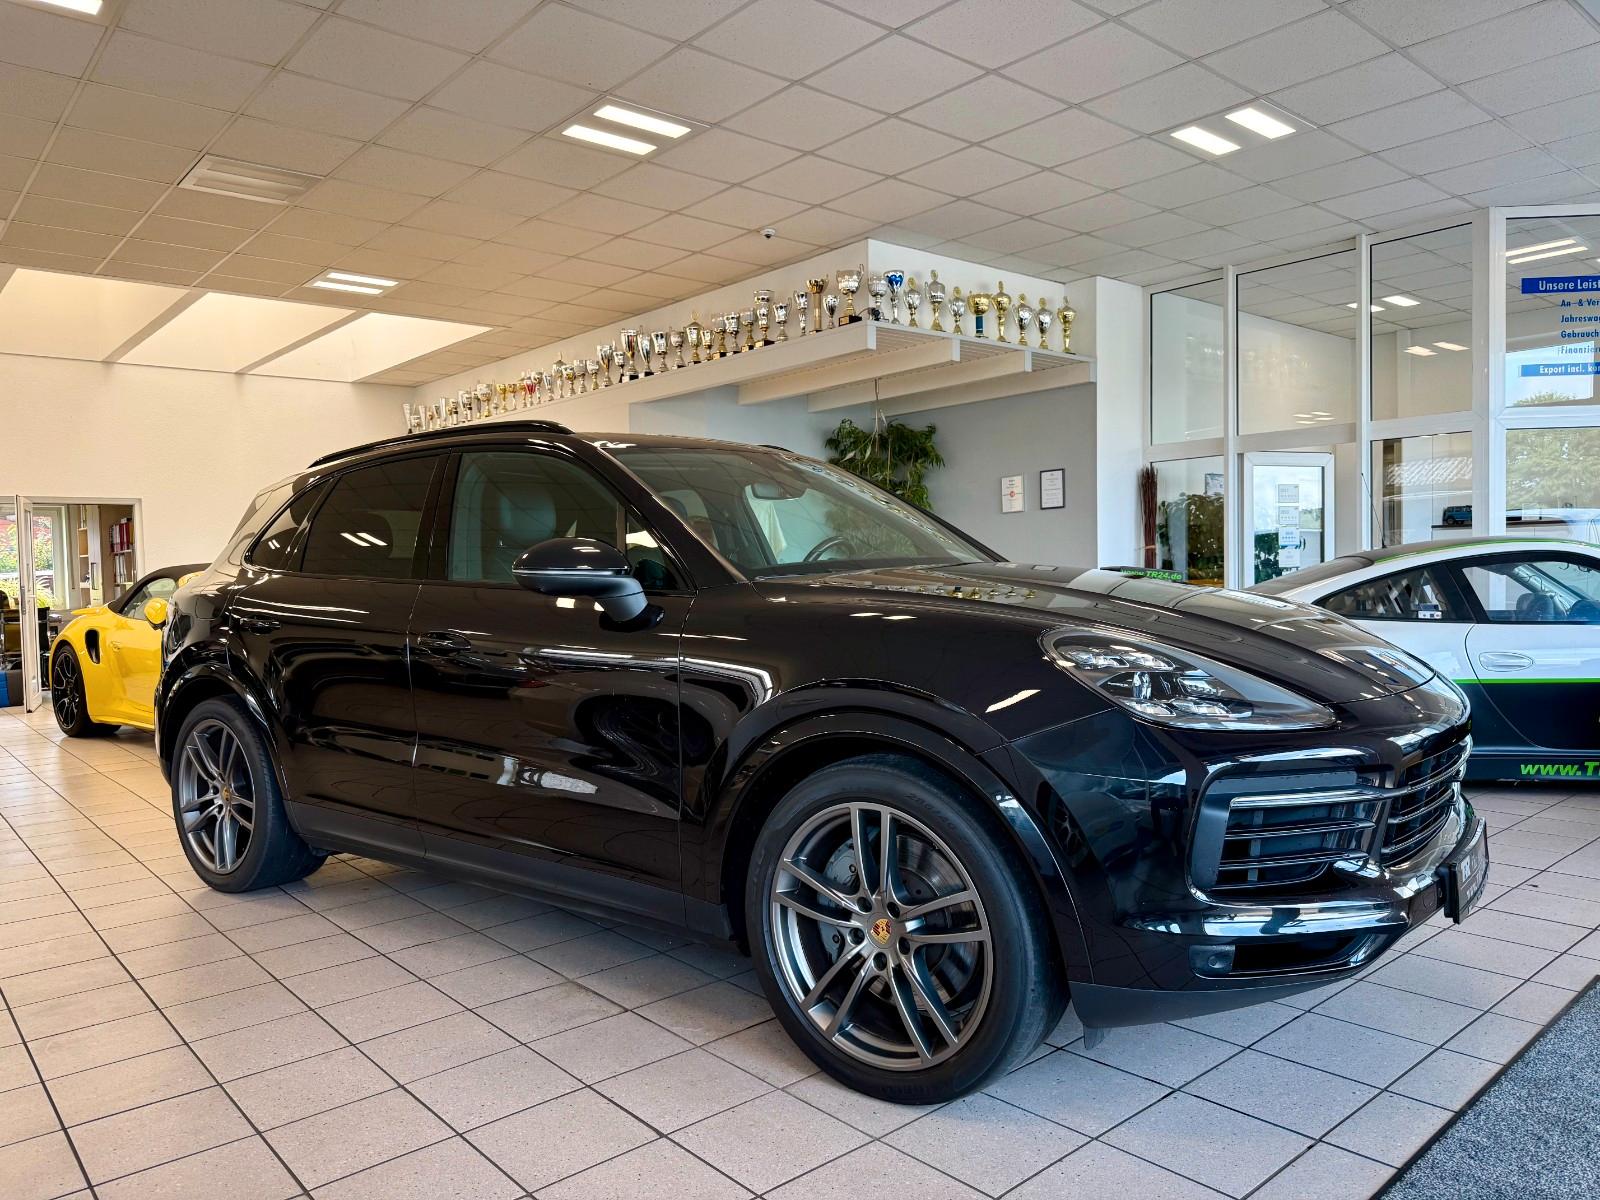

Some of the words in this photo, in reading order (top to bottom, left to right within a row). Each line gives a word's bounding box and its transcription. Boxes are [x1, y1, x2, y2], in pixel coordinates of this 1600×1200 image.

[1539, 280, 1575, 291] Unsere
[1560, 315, 1600, 324] Jahreswa
[1560, 329, 1599, 339] Gebrauch
[1561, 345, 1600, 354] Finanzier
[1539, 366, 1565, 375] Export
[1520, 762, 1600, 776] www.T
